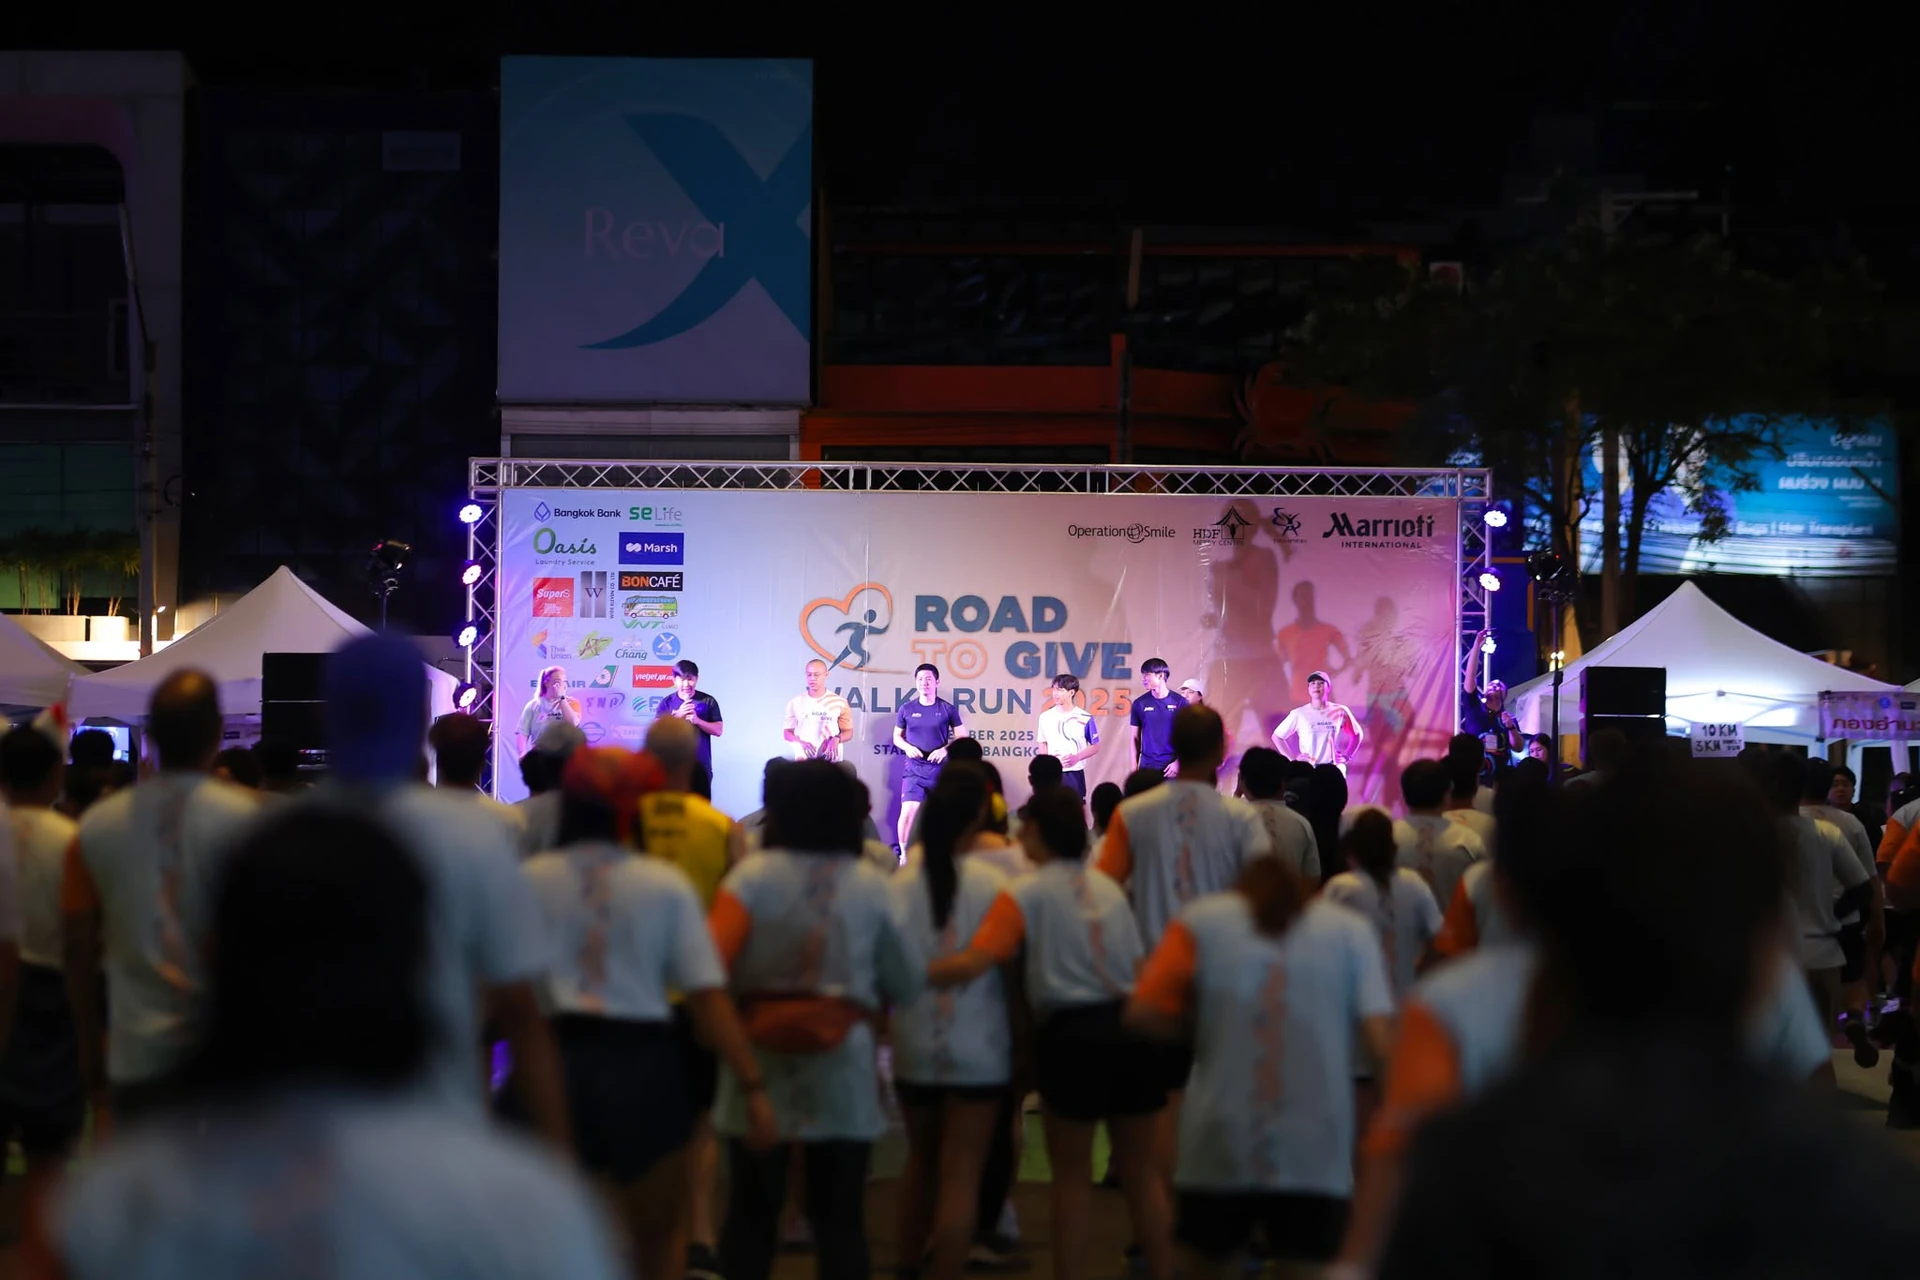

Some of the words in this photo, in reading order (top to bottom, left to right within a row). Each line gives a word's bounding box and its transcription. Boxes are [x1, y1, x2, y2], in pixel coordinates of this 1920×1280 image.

[554, 508, 595, 519] Bangkok
[597, 508, 621, 518] Bank
[1068, 524, 1126, 538] Operation
[1144, 526, 1176, 538] Smile
[1322, 512, 1435, 538] Marriott
[1193, 529, 1220, 539] HDF
[533, 527, 597, 555] Oasis
[644, 543, 677, 553] Marsh
[535, 558, 565, 566] Laundry
[567, 558, 595, 566] Service
[622, 574, 681, 588] BONCAFÉ
[915, 595, 1068, 633] ROAD
[615, 649, 648, 661] Chang
[911, 637, 988, 680] TO
[1004, 640, 1132, 680] GIVE
[953, 687, 1032, 715] RUN
[1000, 730, 1034, 740] 2025
[1702, 724, 1716, 736] 10
[1719, 724, 1738, 736] KM
